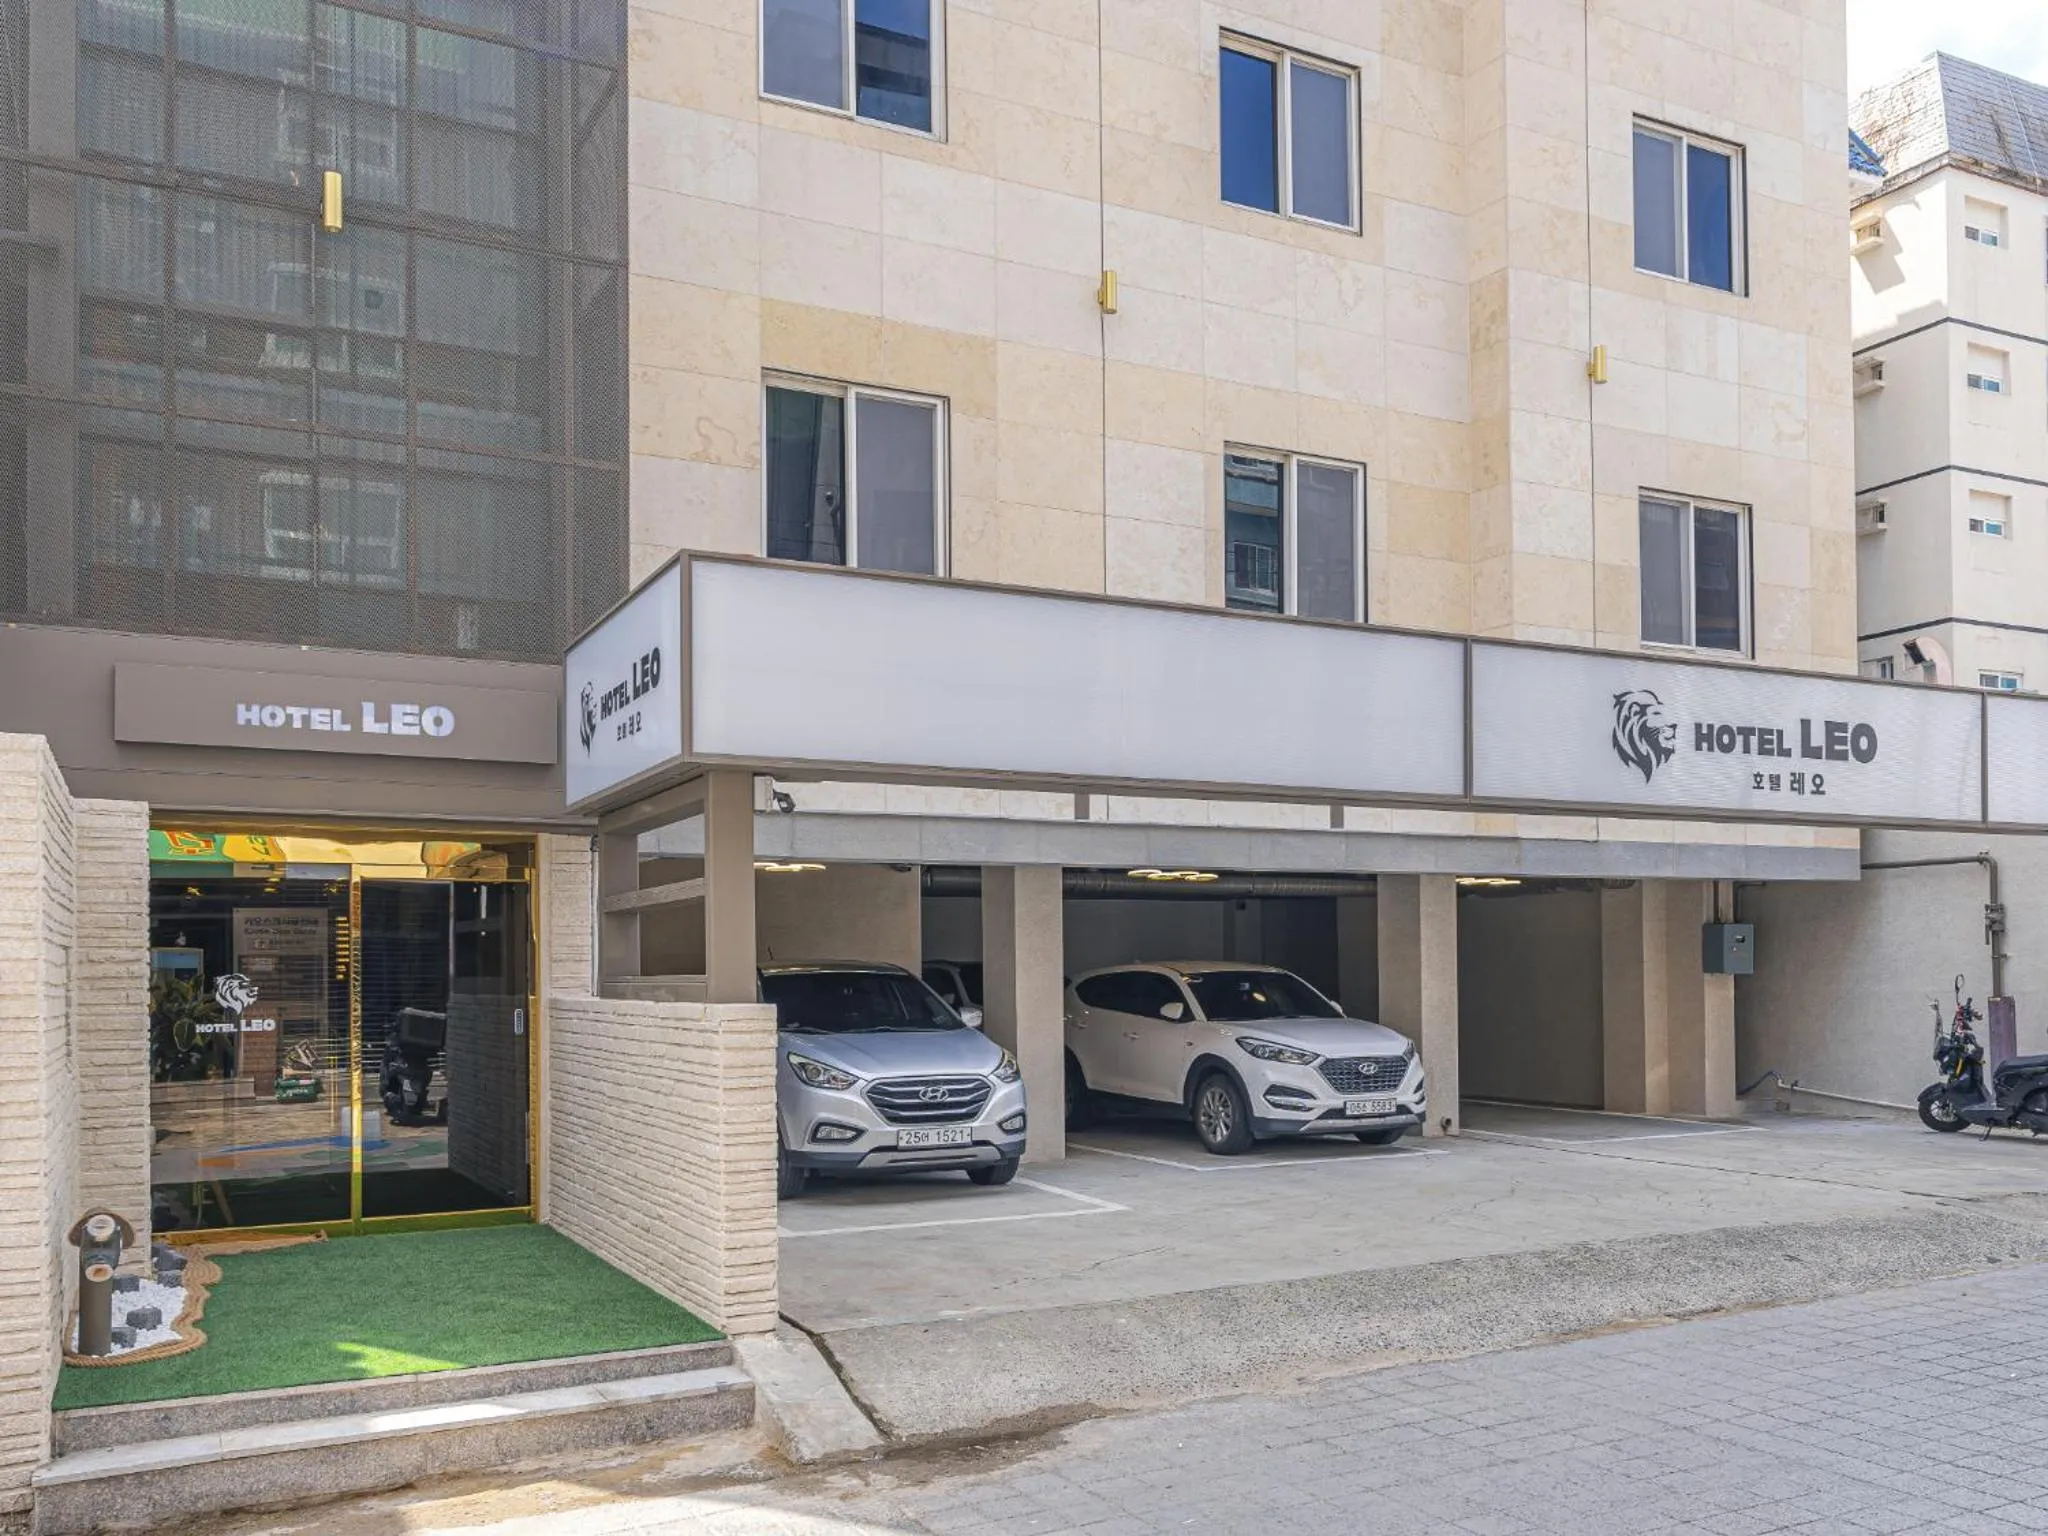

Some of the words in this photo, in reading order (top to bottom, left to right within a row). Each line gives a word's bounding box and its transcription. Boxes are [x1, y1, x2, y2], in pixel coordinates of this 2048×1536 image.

[600, 680, 631, 721] HOTEL
[632, 647, 661, 701] LEO
[236, 703, 351, 732] HOTEL
[361, 701, 455, 737] LEO
[1694, 722, 1792, 758] HOTEL
[1800, 718, 1878, 764] LEO
[1752, 771, 1781, 791] 호텔
[1790, 772, 1826, 795] 레오
[195, 1023, 238, 1033] HOTEL
[240, 1018, 276, 1032] LEO
[936, 1130, 964, 1143] 1521
